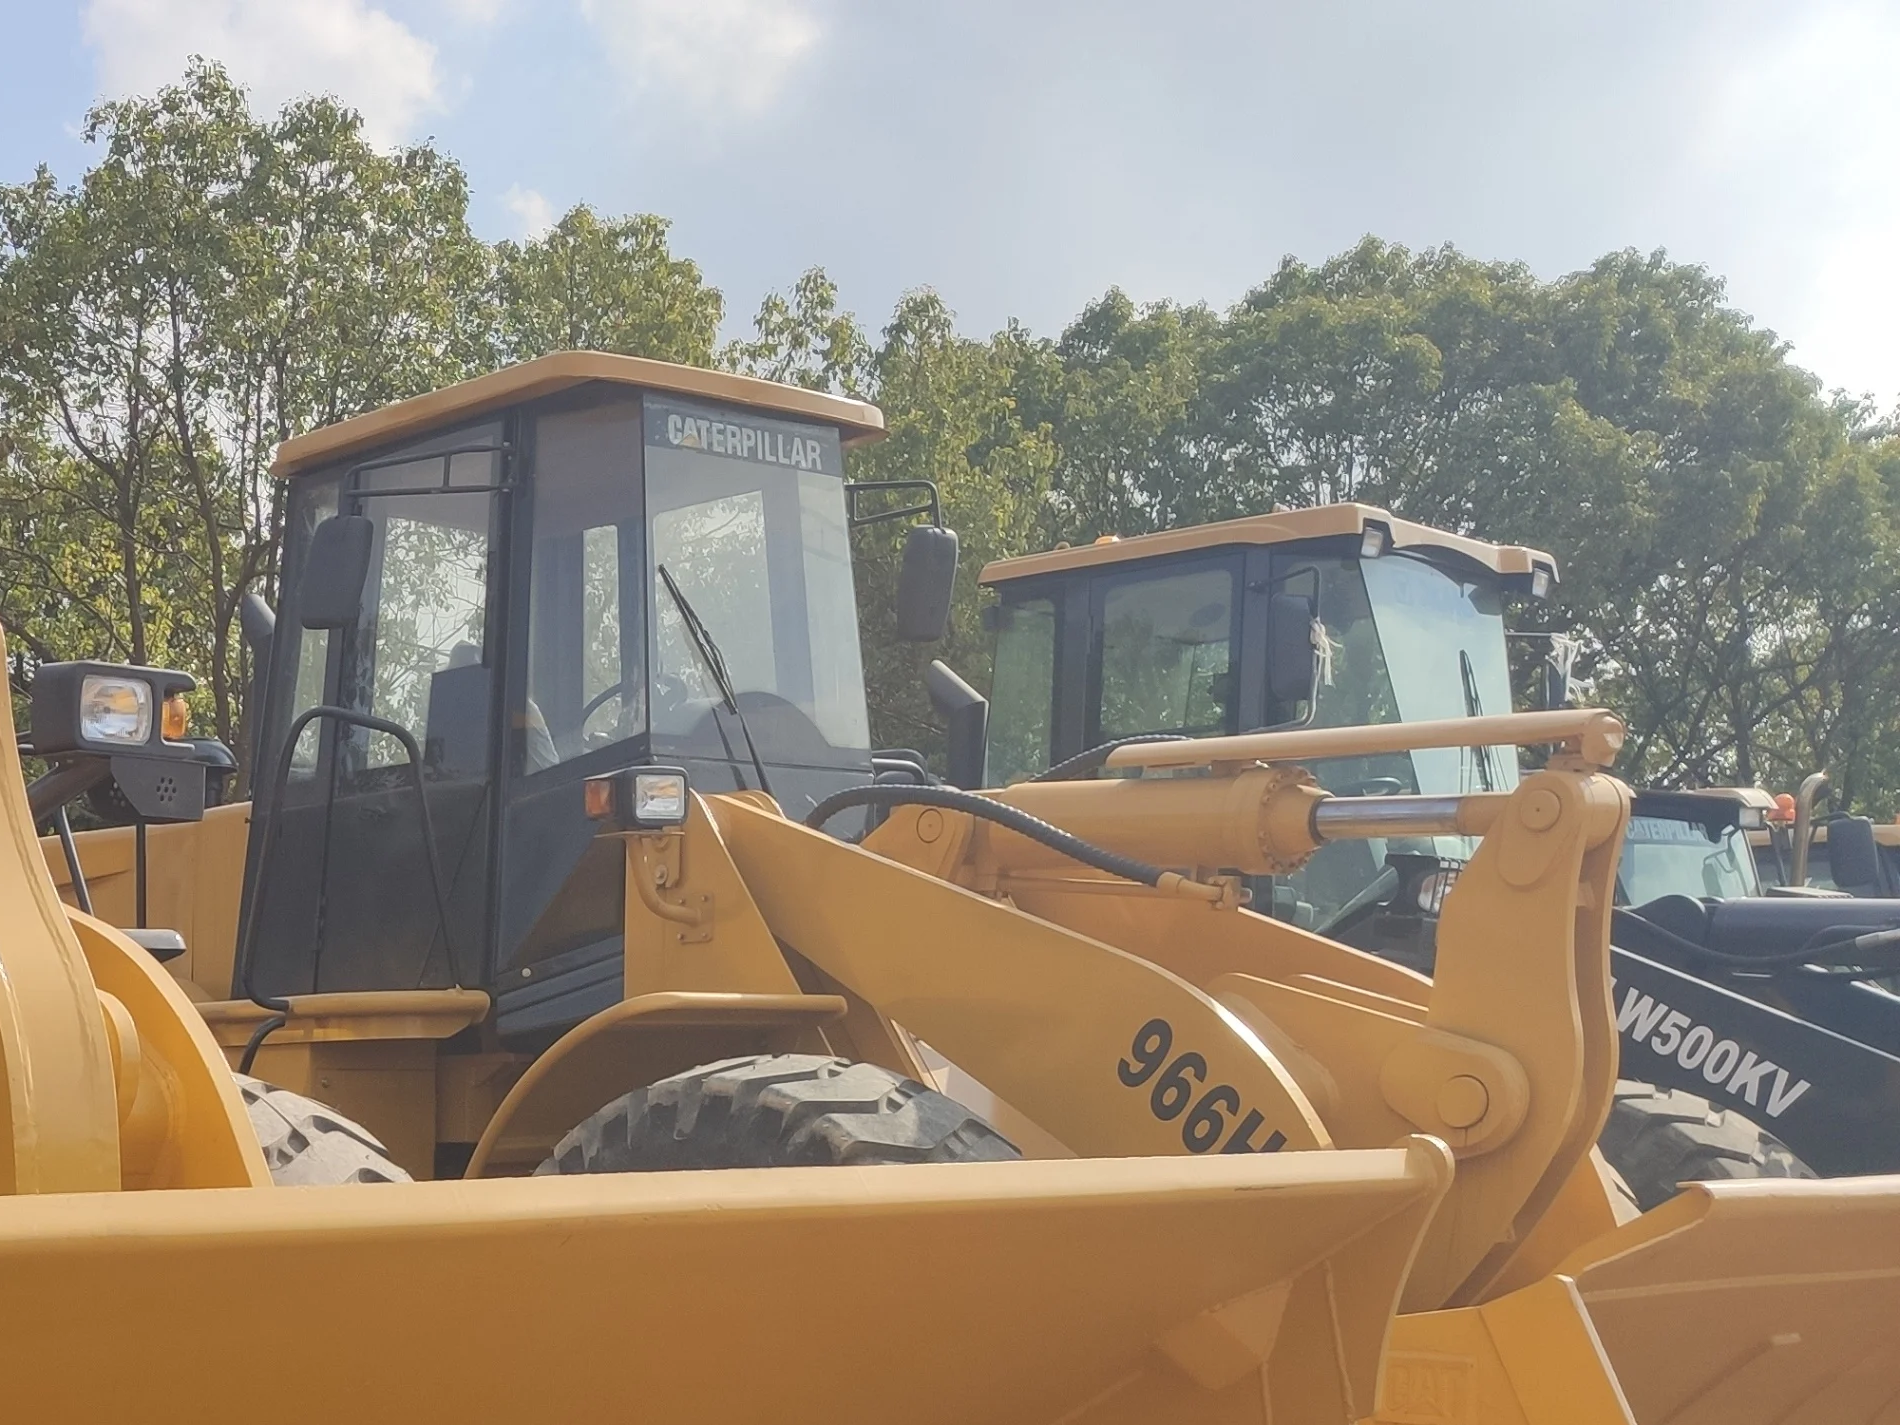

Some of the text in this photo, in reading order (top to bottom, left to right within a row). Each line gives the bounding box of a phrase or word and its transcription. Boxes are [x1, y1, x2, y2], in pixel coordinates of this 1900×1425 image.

[667, 414, 822, 471] CATERPILLAR
[1625, 819, 1709, 841] CATERPILLAR
[1611, 976, 1811, 1118] W500KV
